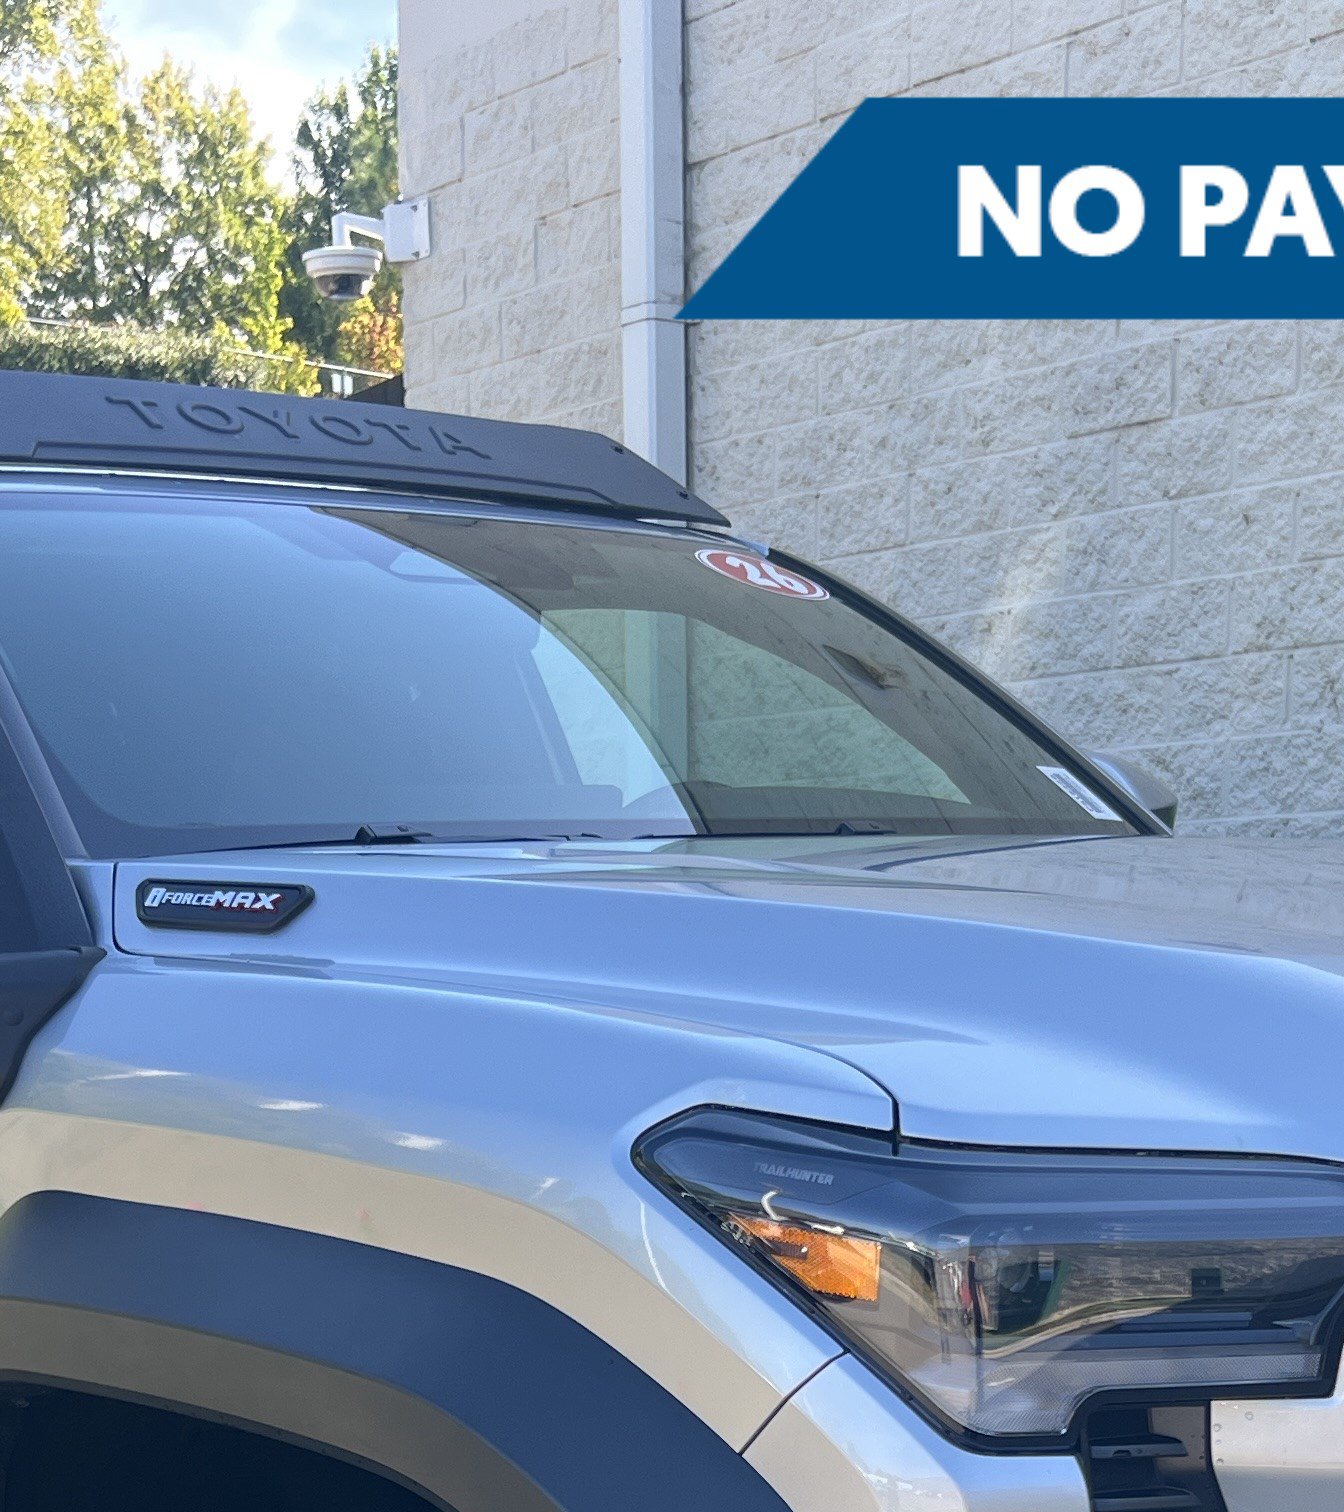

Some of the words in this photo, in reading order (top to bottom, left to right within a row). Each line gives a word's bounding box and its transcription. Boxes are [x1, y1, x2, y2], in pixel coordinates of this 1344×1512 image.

[105, 395, 492, 460] TOYOTA
[725, 556, 809, 594] 26
[754, 1162, 834, 1186] TRAILHUNTER
